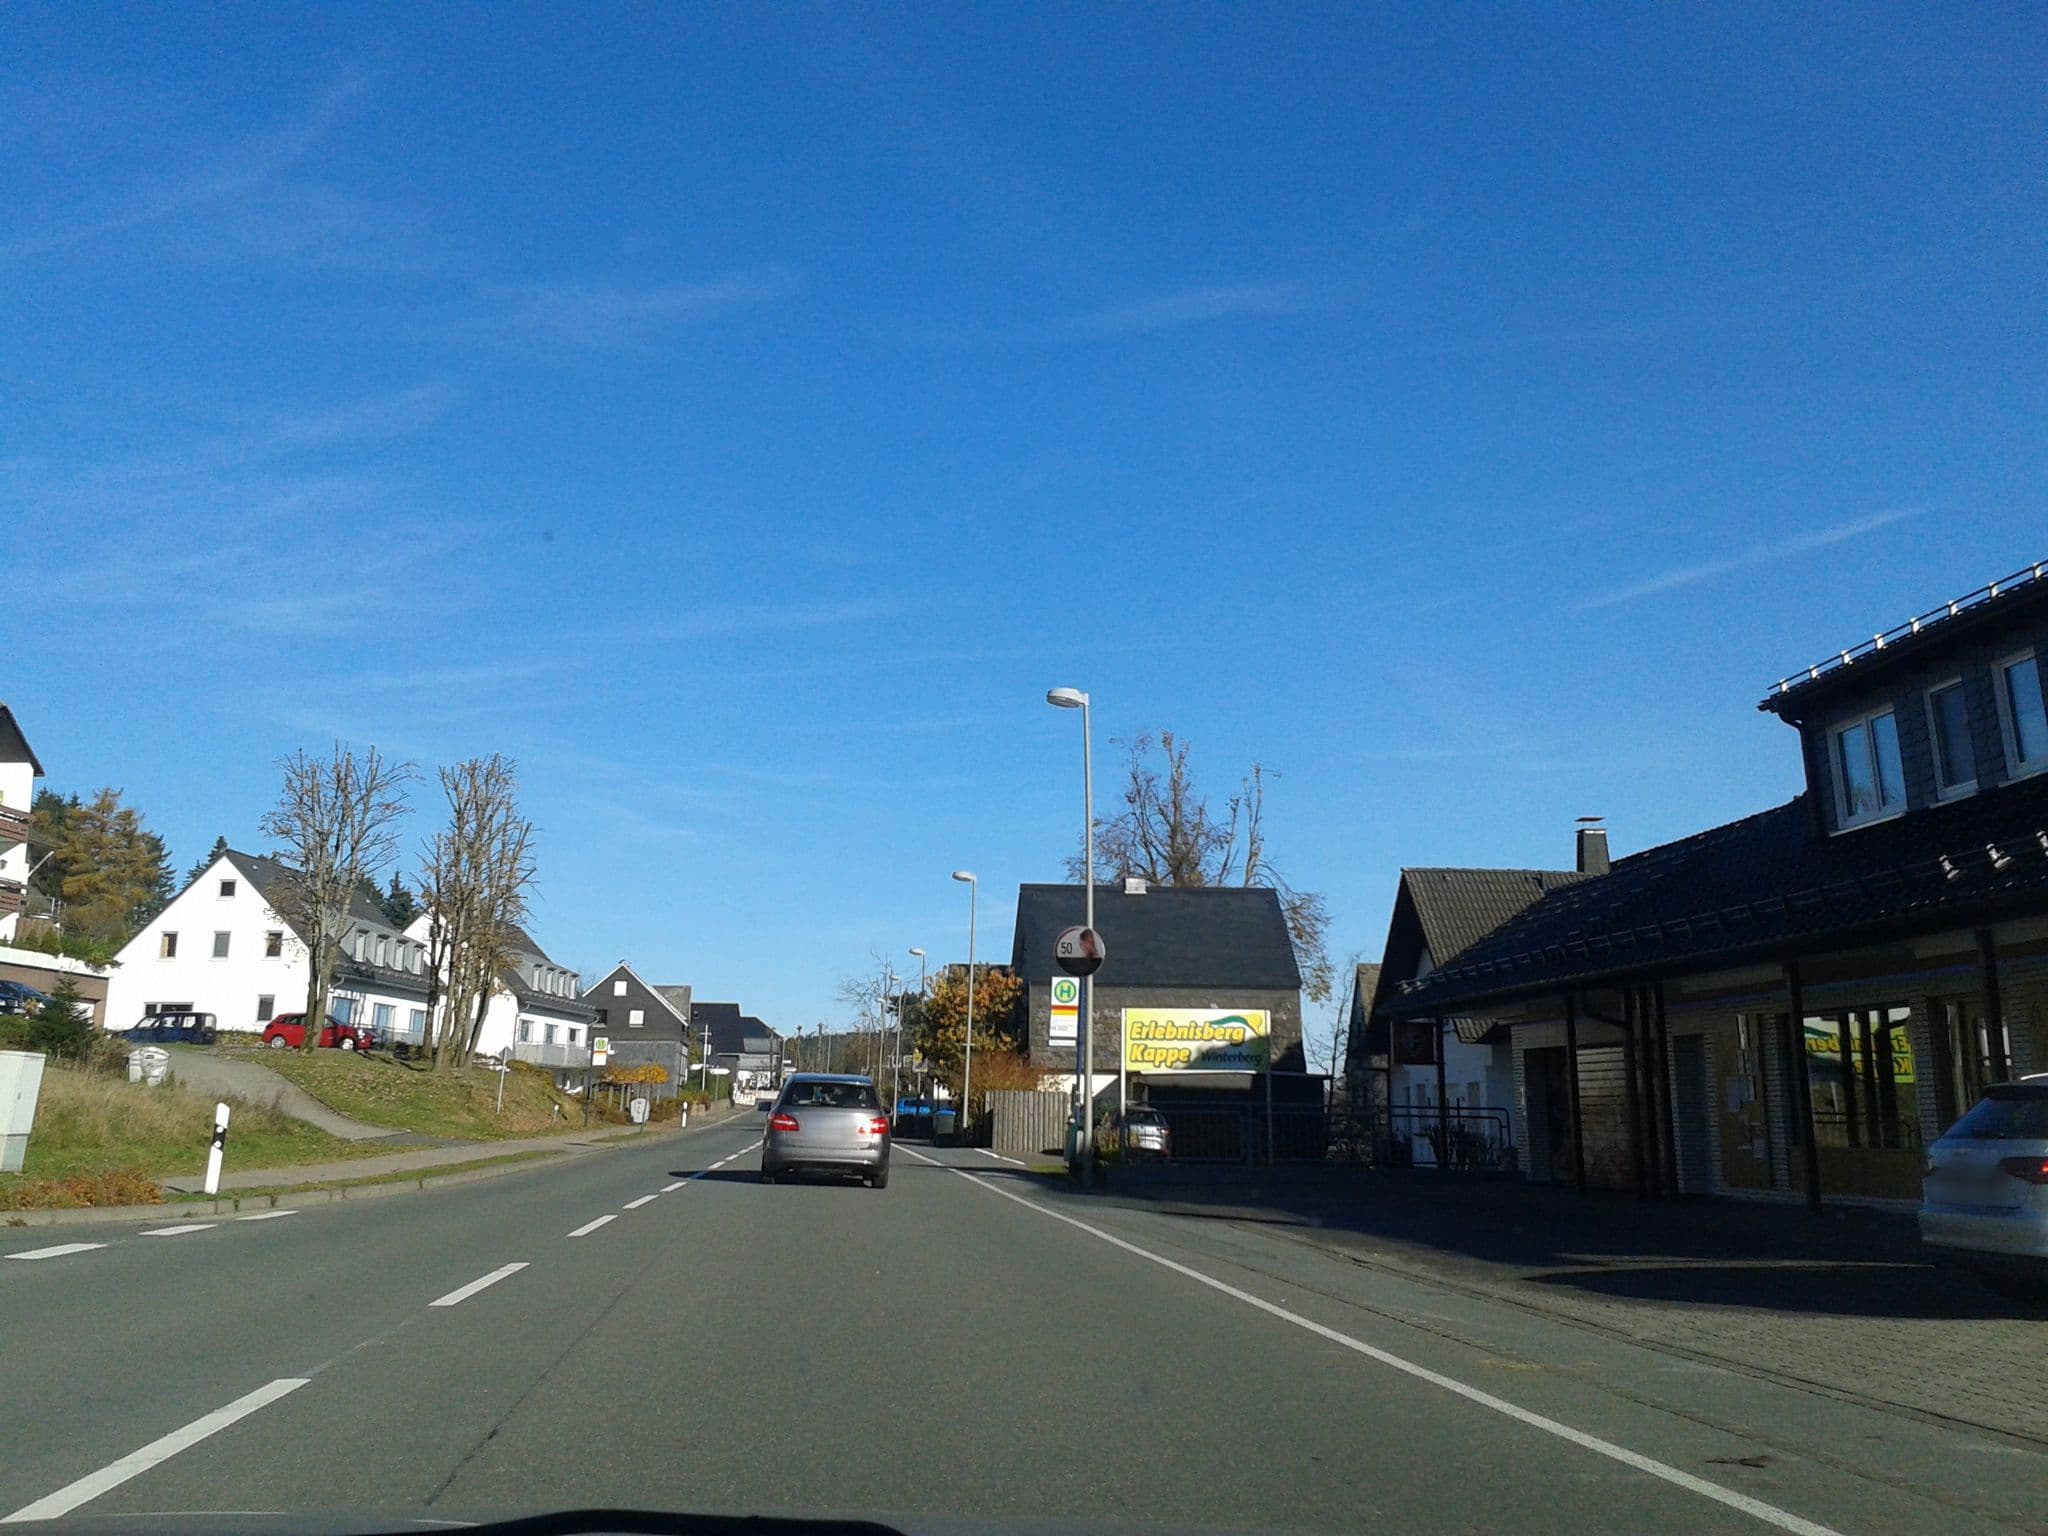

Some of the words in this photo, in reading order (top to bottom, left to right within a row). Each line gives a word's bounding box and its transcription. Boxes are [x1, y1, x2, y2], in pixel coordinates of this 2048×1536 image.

[1061, 942, 1073, 954] 50
[1060, 986, 1071, 998] H
[1130, 1020, 1245, 1046] Erlebnisberg
[1129, 1043, 1192, 1068] Kappe
[1201, 1050, 1262, 1067] Winterberg
